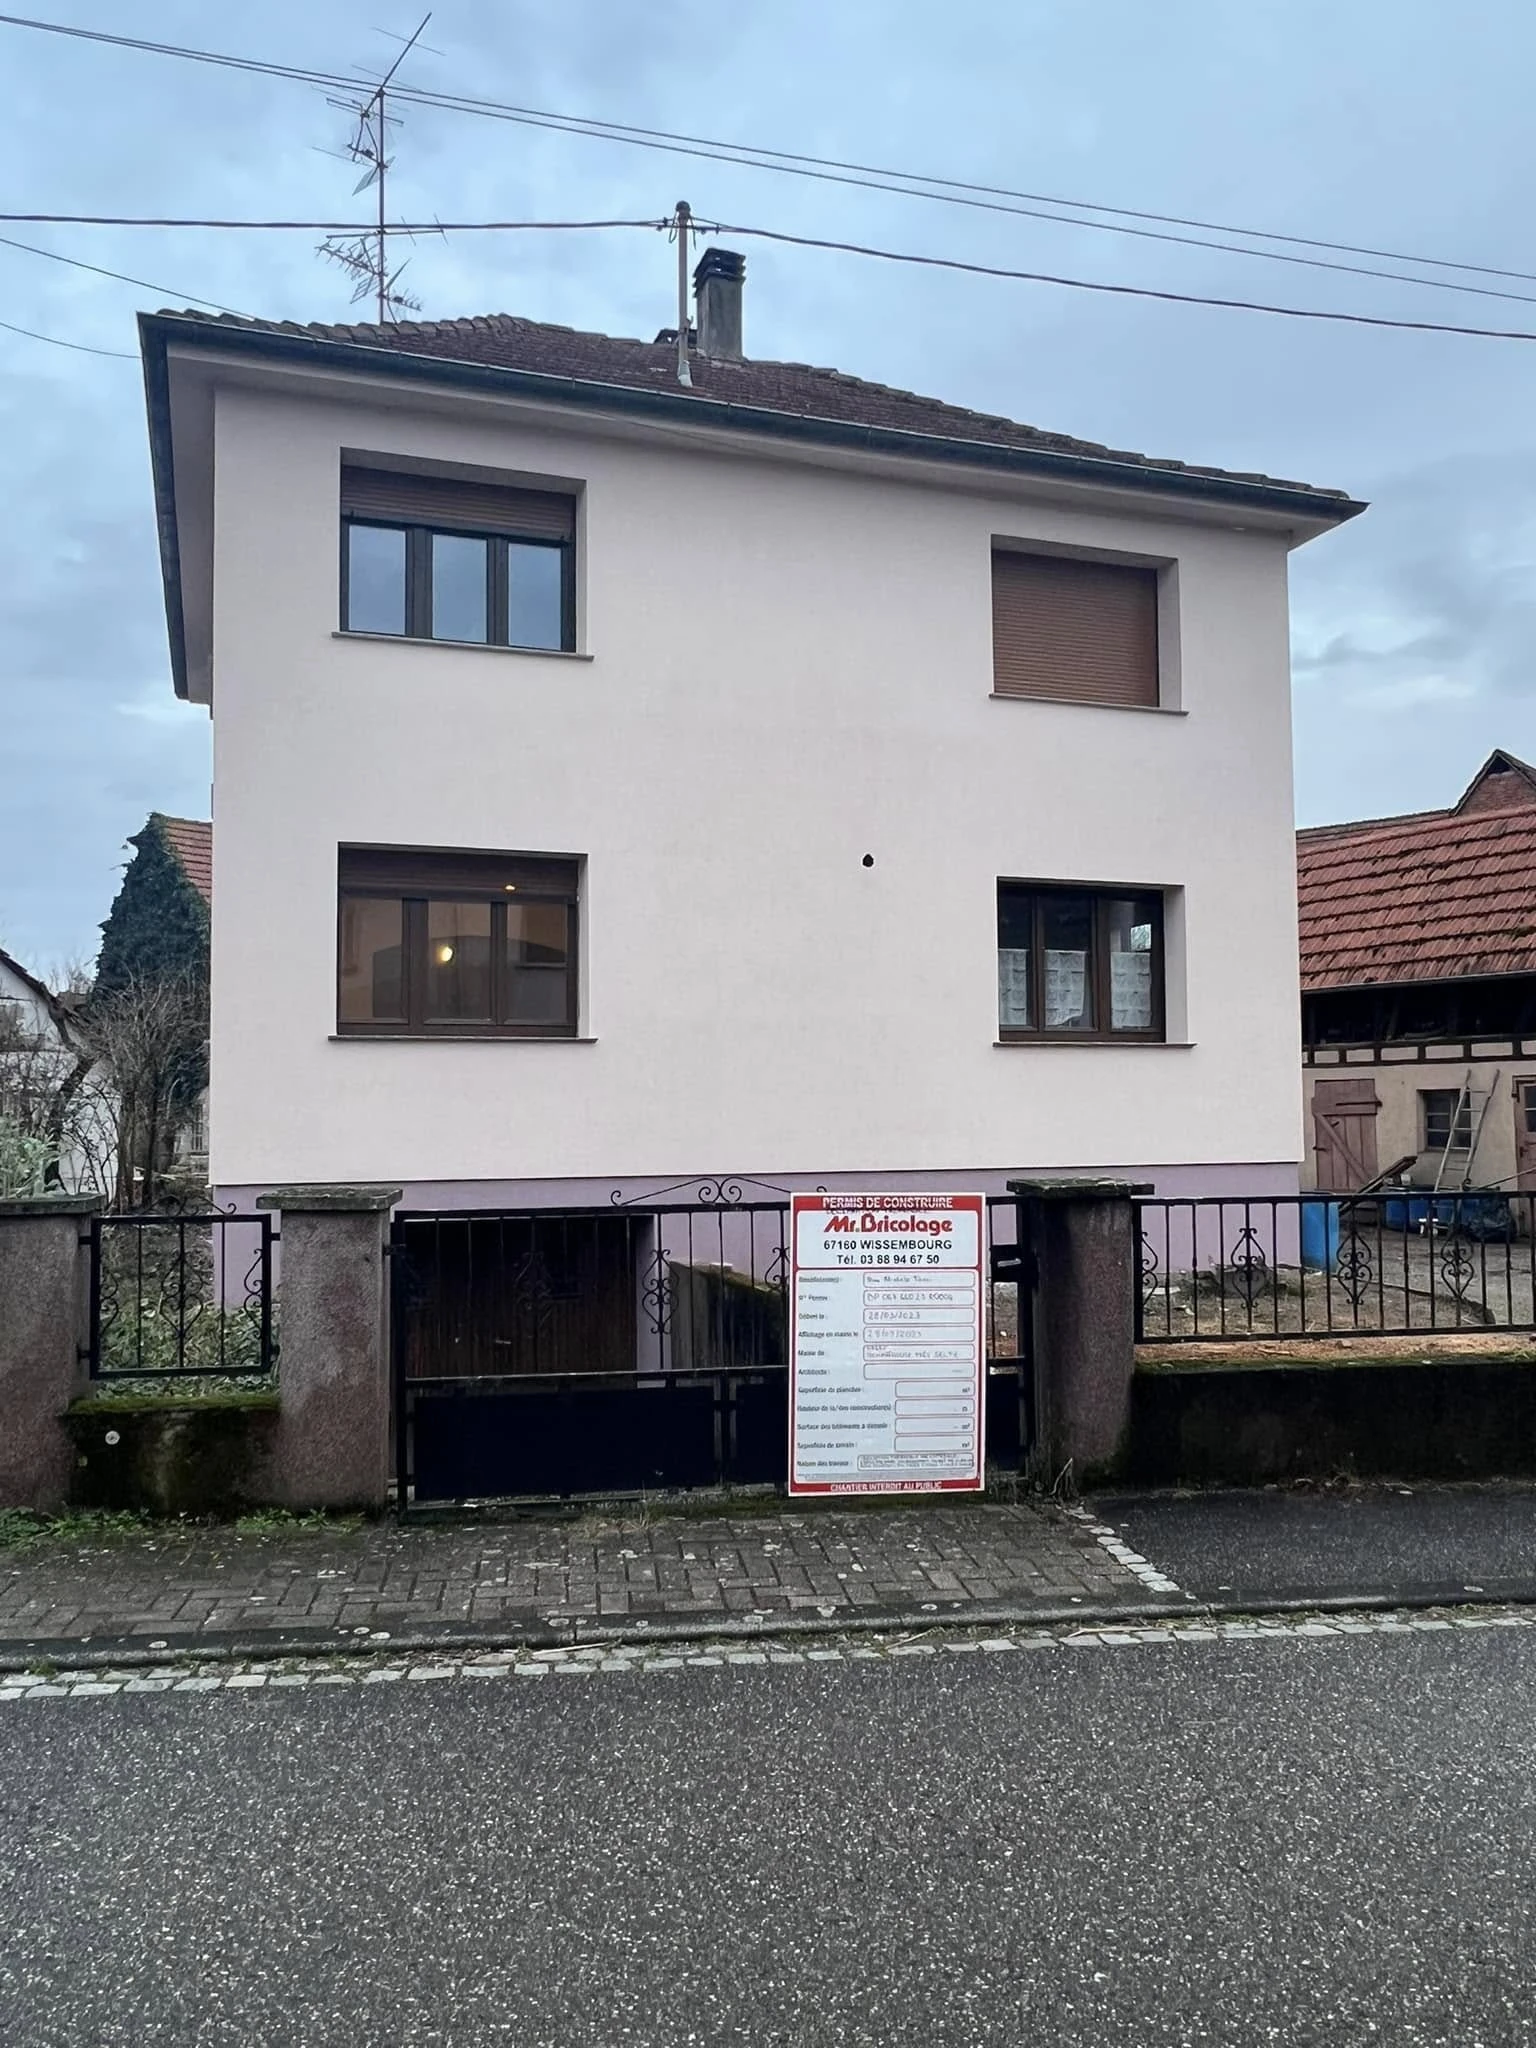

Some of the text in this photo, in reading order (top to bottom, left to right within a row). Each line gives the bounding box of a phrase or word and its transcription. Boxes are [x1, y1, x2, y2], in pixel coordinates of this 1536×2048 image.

[822, 1196, 953, 1208] PERMIS DE CONSTRUIRE
[823, 1239, 952, 1250] 67160 WISSEMBOURG
[860, 1254, 873, 1265] 03
[877, 1254, 890, 1265] 88
[893, 1254, 907, 1265] 94
[910, 1254, 922, 1265] 67
[926, 1254, 940, 1265] 50
